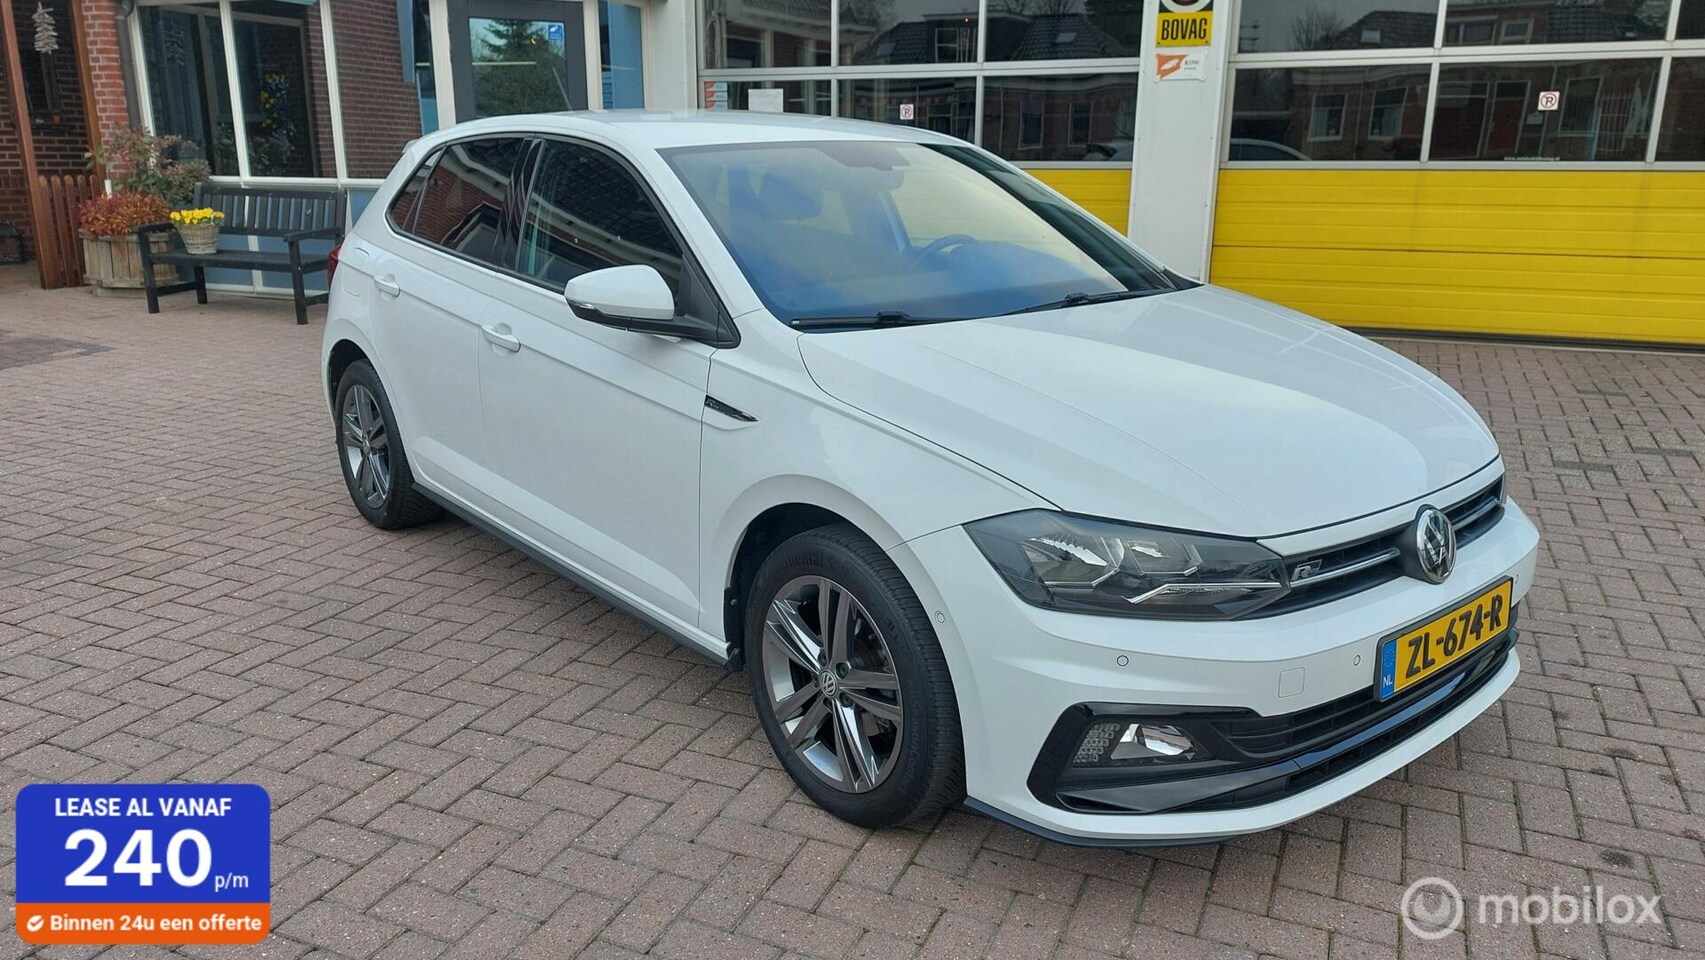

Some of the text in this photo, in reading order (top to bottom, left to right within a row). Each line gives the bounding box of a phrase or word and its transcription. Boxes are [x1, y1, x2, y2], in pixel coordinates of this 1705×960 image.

[1161, 18, 1207, 40] BOVAG
[1405, 594, 1503, 679] ZL-674-R
[1382, 675, 1393, 687] NL
